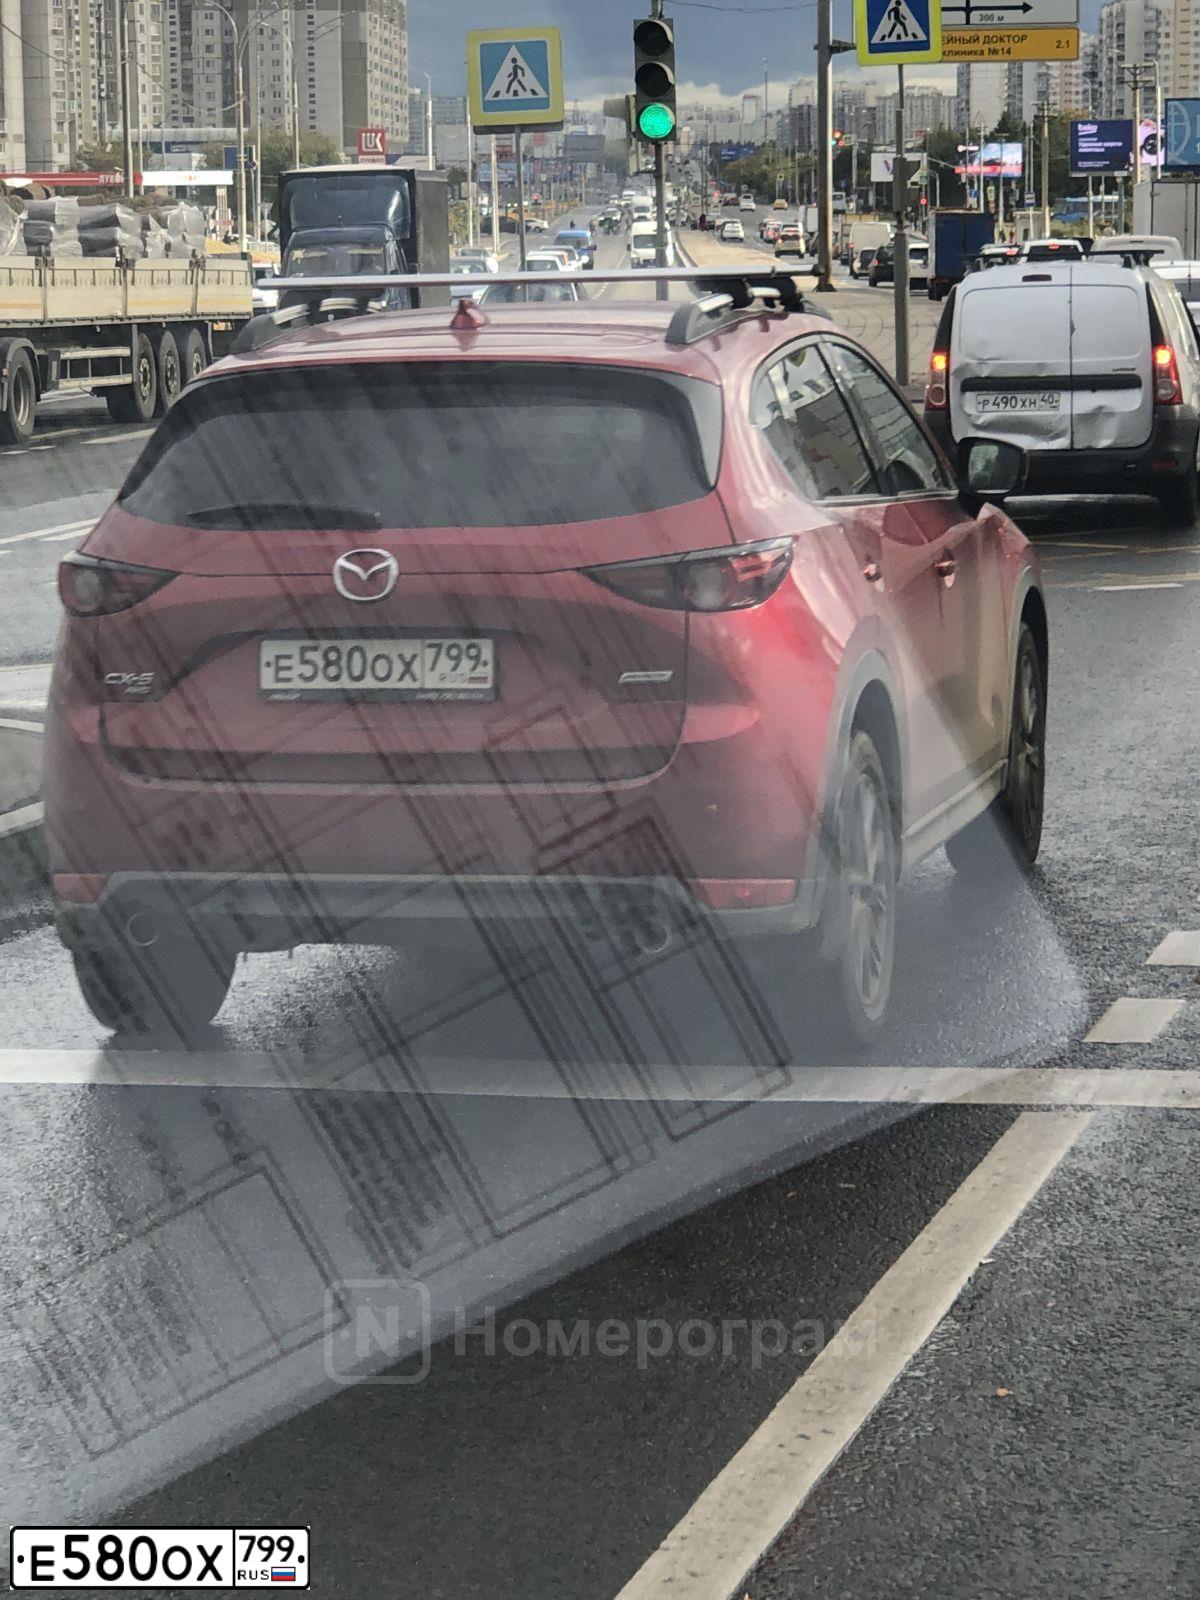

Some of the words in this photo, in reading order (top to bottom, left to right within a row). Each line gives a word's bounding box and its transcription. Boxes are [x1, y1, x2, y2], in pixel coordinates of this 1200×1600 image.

[979, 13, 995, 22] 300
[982, 34, 1028, 45] ДОКТОР
[1055, 39, 1071, 49] 2.1
[426, 642, 482, 672] 799
